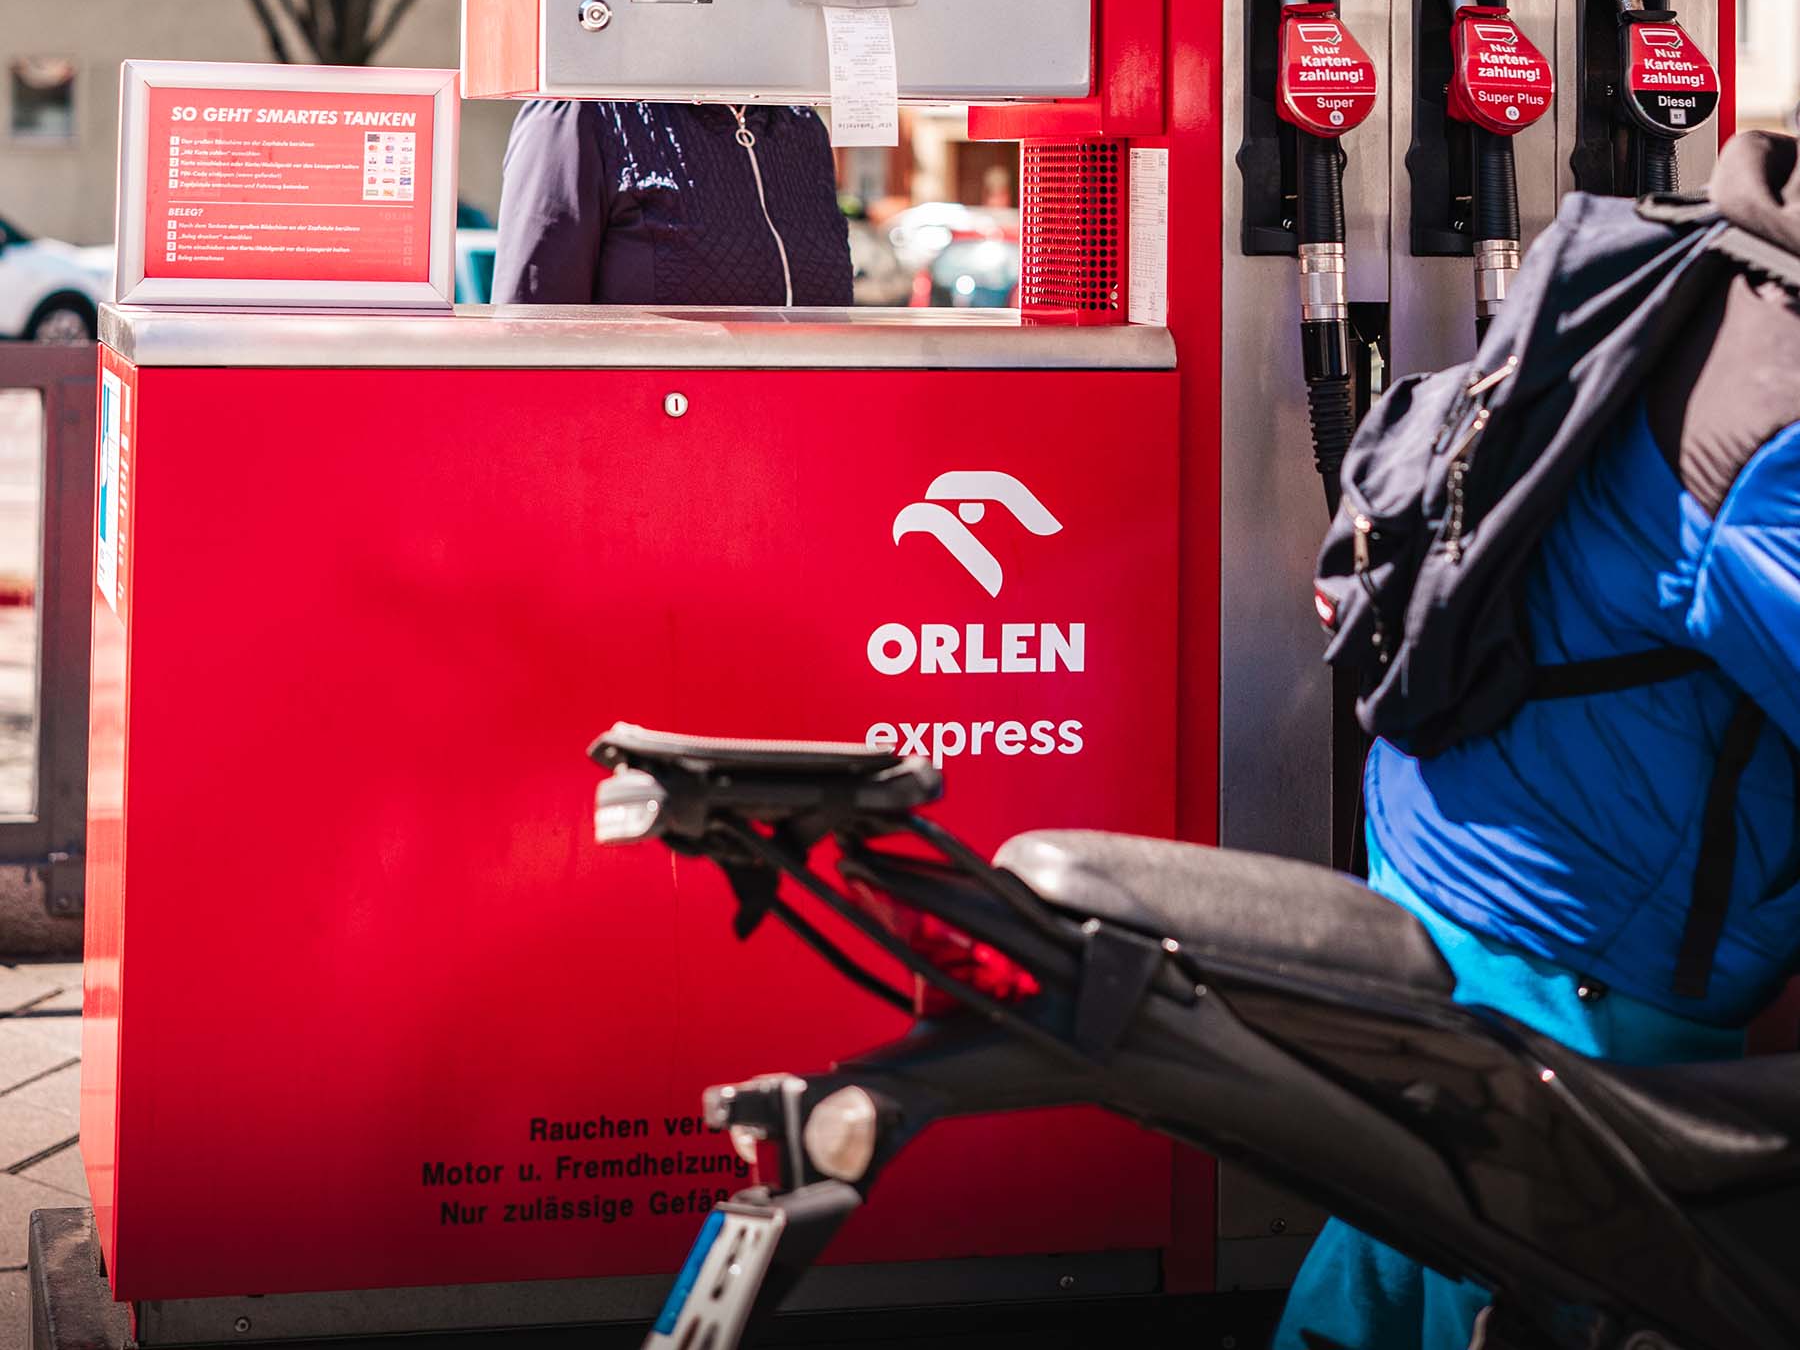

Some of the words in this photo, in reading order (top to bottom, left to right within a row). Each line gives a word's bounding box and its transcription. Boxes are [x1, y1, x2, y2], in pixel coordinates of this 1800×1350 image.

[1312, 45, 1340, 54] Nur
[1489, 43, 1517, 53] Nur
[1654, 48, 1682, 58] Nur
[1300, 55, 1358, 67] Karten-
[1479, 52, 1535, 66] Karten-
[1643, 58, 1699, 71] Karten-
[1298, 68, 1364, 84] zahlung!
[1478, 65, 1541, 82] zahlung!
[1642, 71, 1705, 87] zahlung!
[1316, 96, 1354, 110] Super
[1478, 90, 1515, 105] Super
[1517, 92, 1544, 105] Plus
[1657, 95, 1696, 108] Diesel
[171, 106, 198, 122] SO
[203, 107, 252, 123] GEHT
[256, 109, 338, 125] SMARTES
[343, 111, 416, 127] TANKEN
[167, 207, 204, 217] BELEG?
[866, 622, 1085, 675] ORLEN
[865, 718, 1084, 769] express
[529, 1115, 649, 1141] Rauchen
[664, 1116, 722, 1135] ver
[422, 1161, 504, 1186] Motor
[519, 1163, 542, 1182] u.
[556, 1150, 749, 1179] Fremdheizung
[440, 1201, 488, 1226] Nur
[503, 1195, 634, 1224] zulässige
